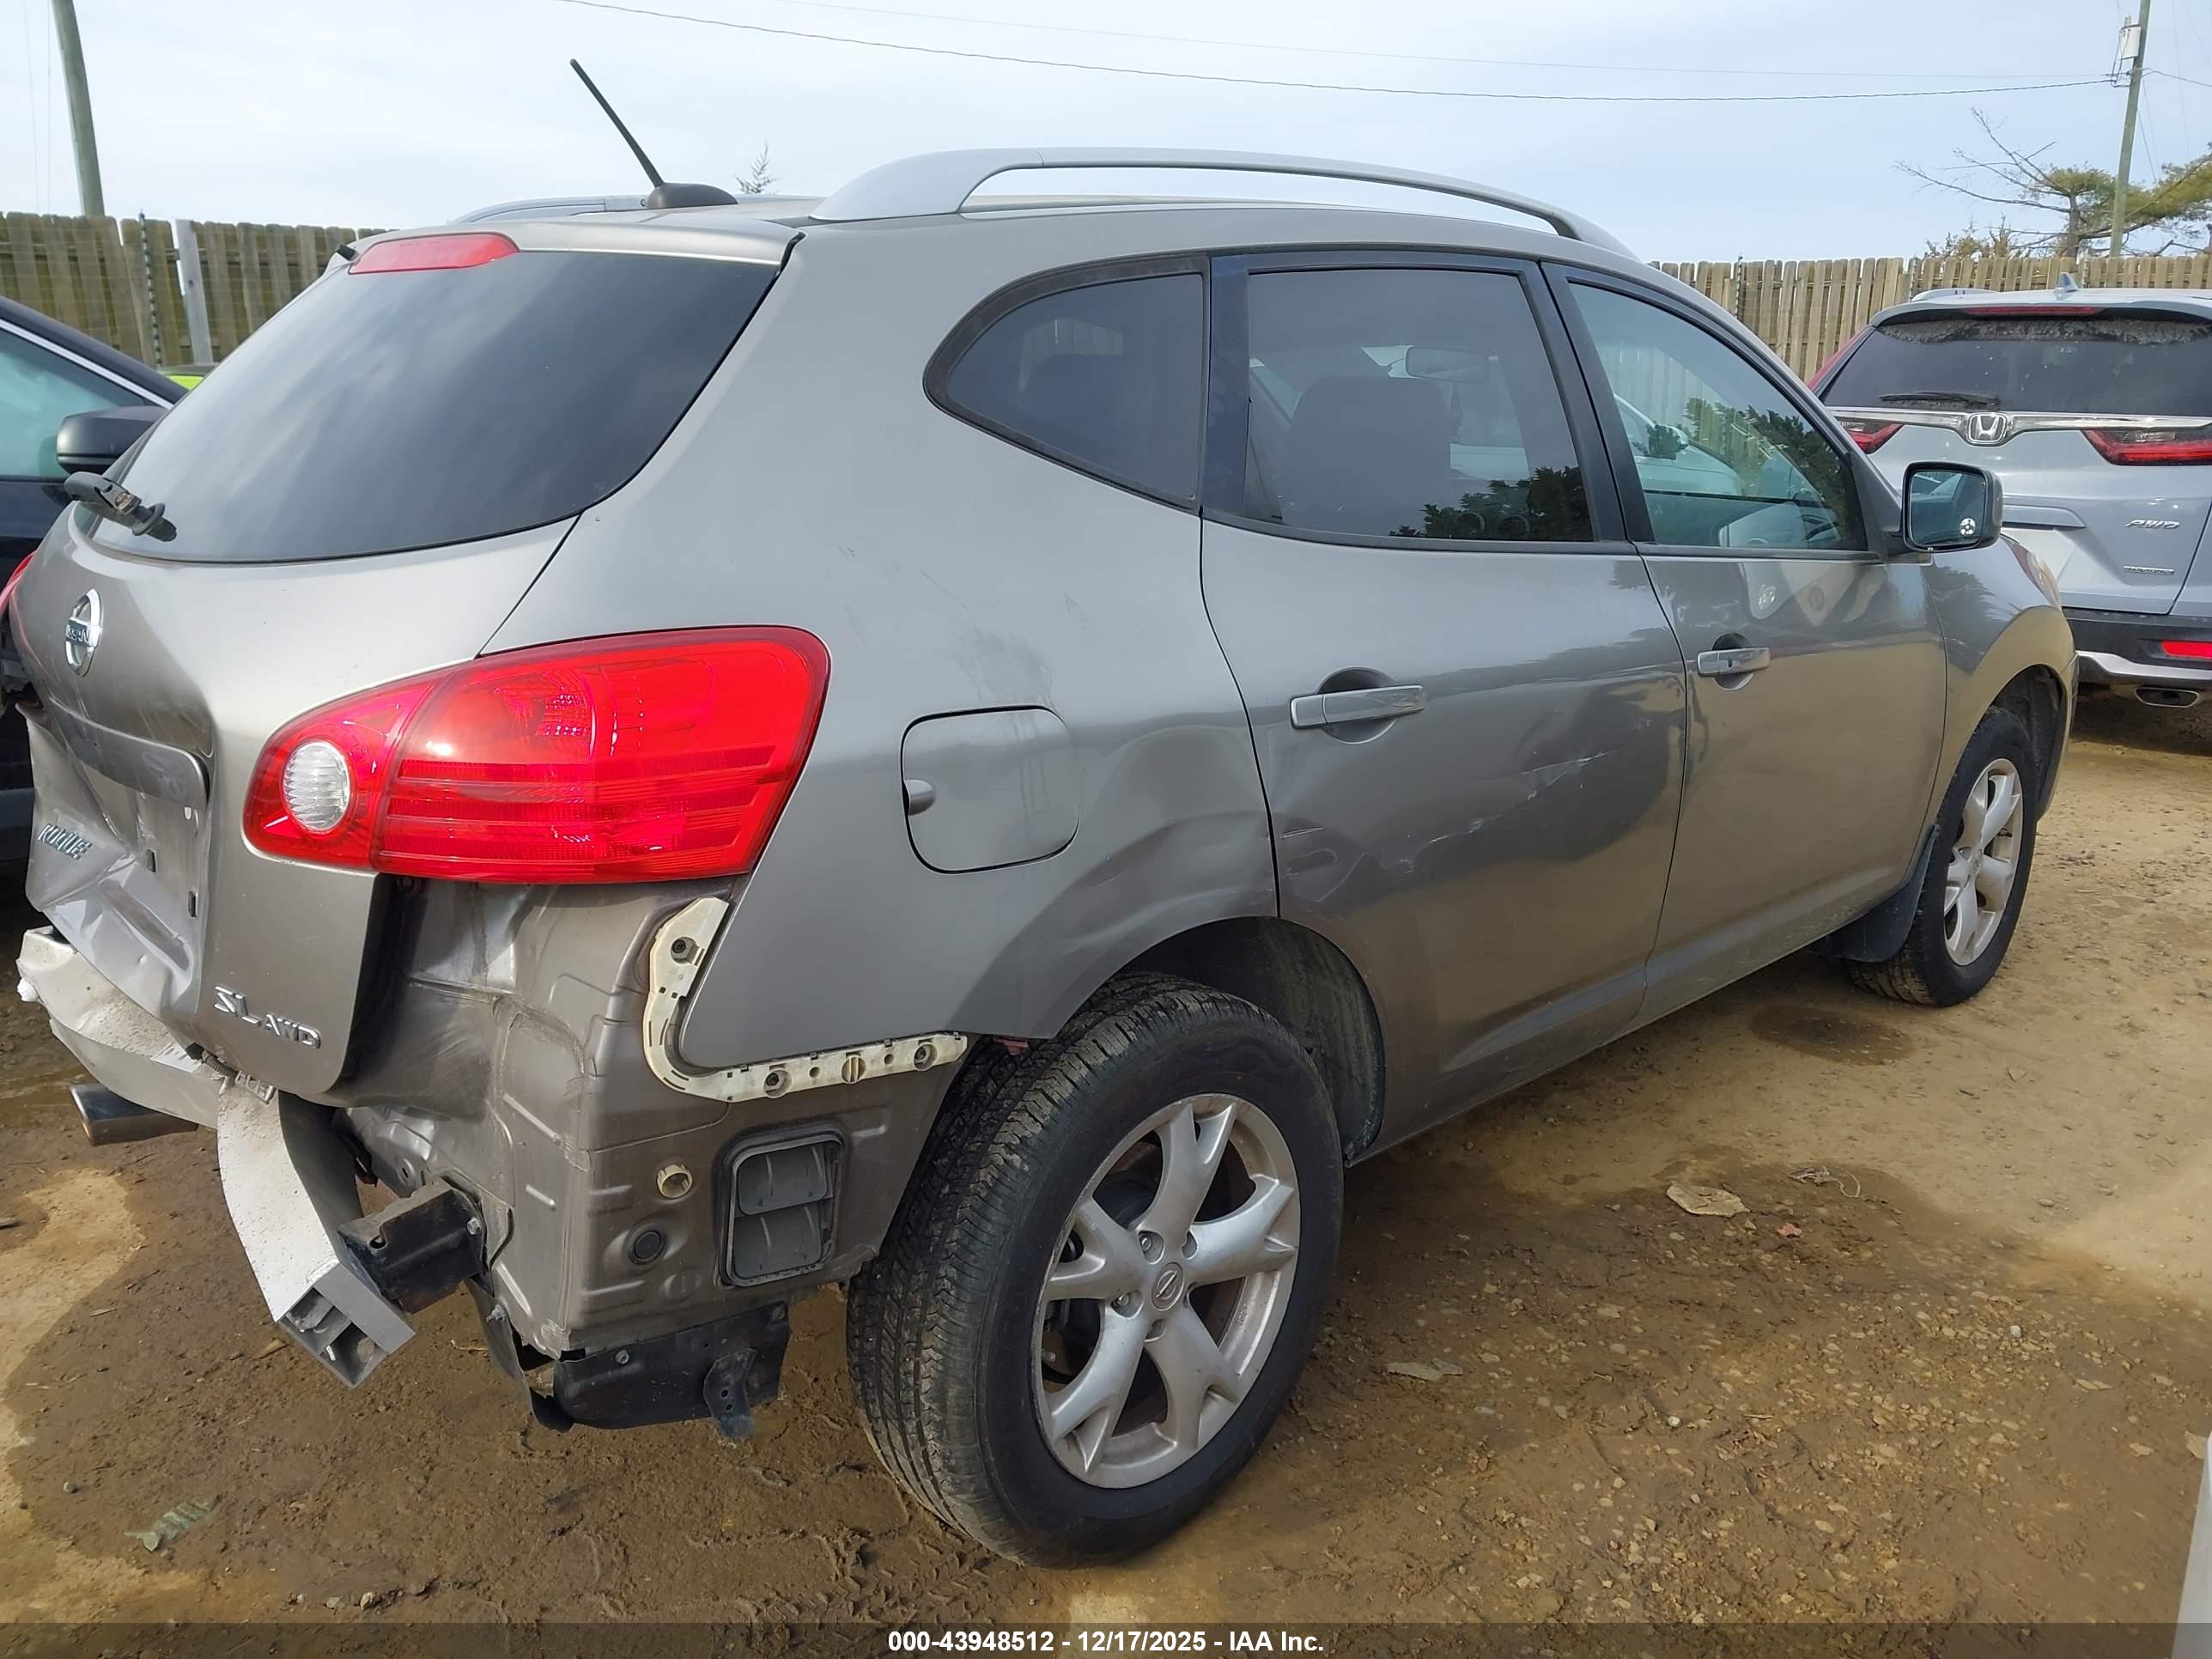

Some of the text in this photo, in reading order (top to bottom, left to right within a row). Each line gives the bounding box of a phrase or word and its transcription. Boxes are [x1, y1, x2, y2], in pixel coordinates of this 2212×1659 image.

[2124, 519, 2180, 529] AWD
[37, 823, 92, 860] ROGUE
[214, 986, 321, 1049] SL AWD
